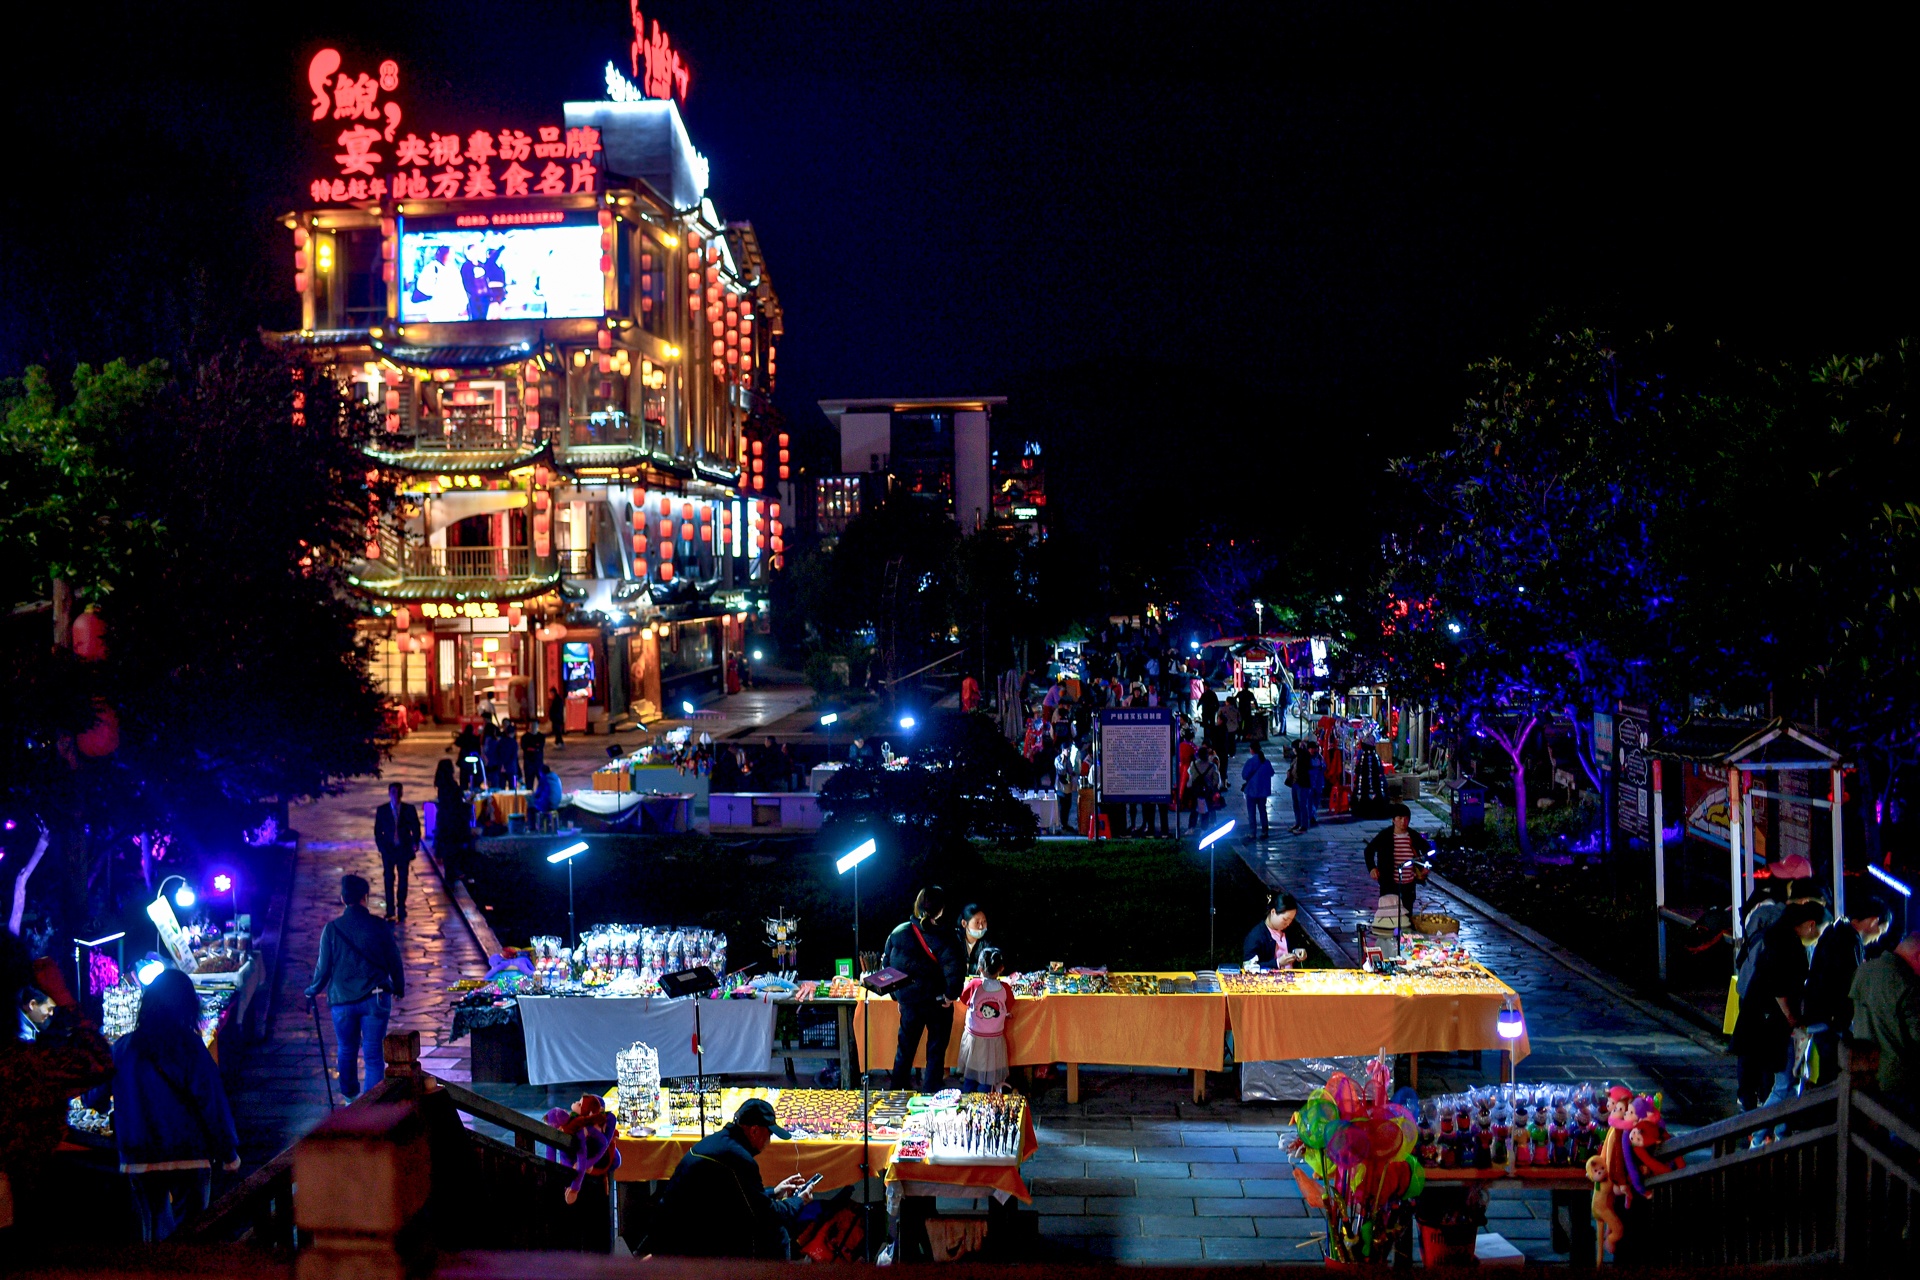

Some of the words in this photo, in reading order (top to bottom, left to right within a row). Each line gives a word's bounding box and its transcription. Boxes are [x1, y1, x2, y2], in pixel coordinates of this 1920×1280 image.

[395, 126, 602, 166] 央視專訪品牌
[392, 159, 598, 200] 地方美食名片
[1110, 712, 1162, 721] 严格落实五项制度
